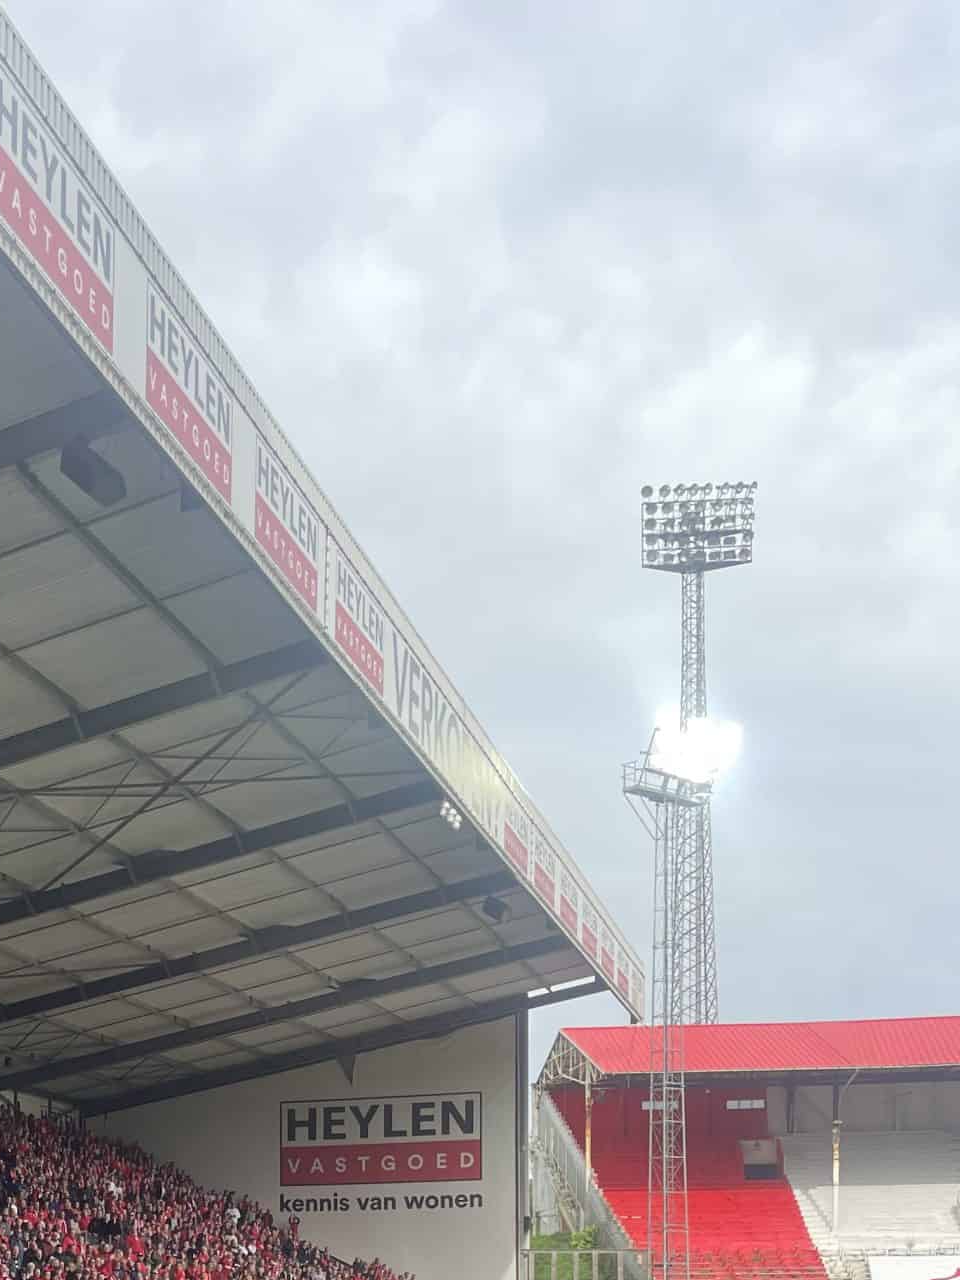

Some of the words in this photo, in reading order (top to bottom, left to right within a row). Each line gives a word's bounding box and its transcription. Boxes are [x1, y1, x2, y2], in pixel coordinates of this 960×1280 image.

[150, 295, 230, 450] HEYLEN
[150, 367, 230, 486] VASTGOED
[258, 446, 318, 561] HEYLEN
[257, 509, 317, 598] VASTGOED
[336, 556, 384, 651] HEYLEN
[287, 1100, 475, 1141] HEYLEN
[288, 1152, 475, 1174] VASTGOED
[280, 1193, 350, 1213] kennis
[357, 1196, 396, 1211] van
[404, 1193, 483, 1210] wonen
